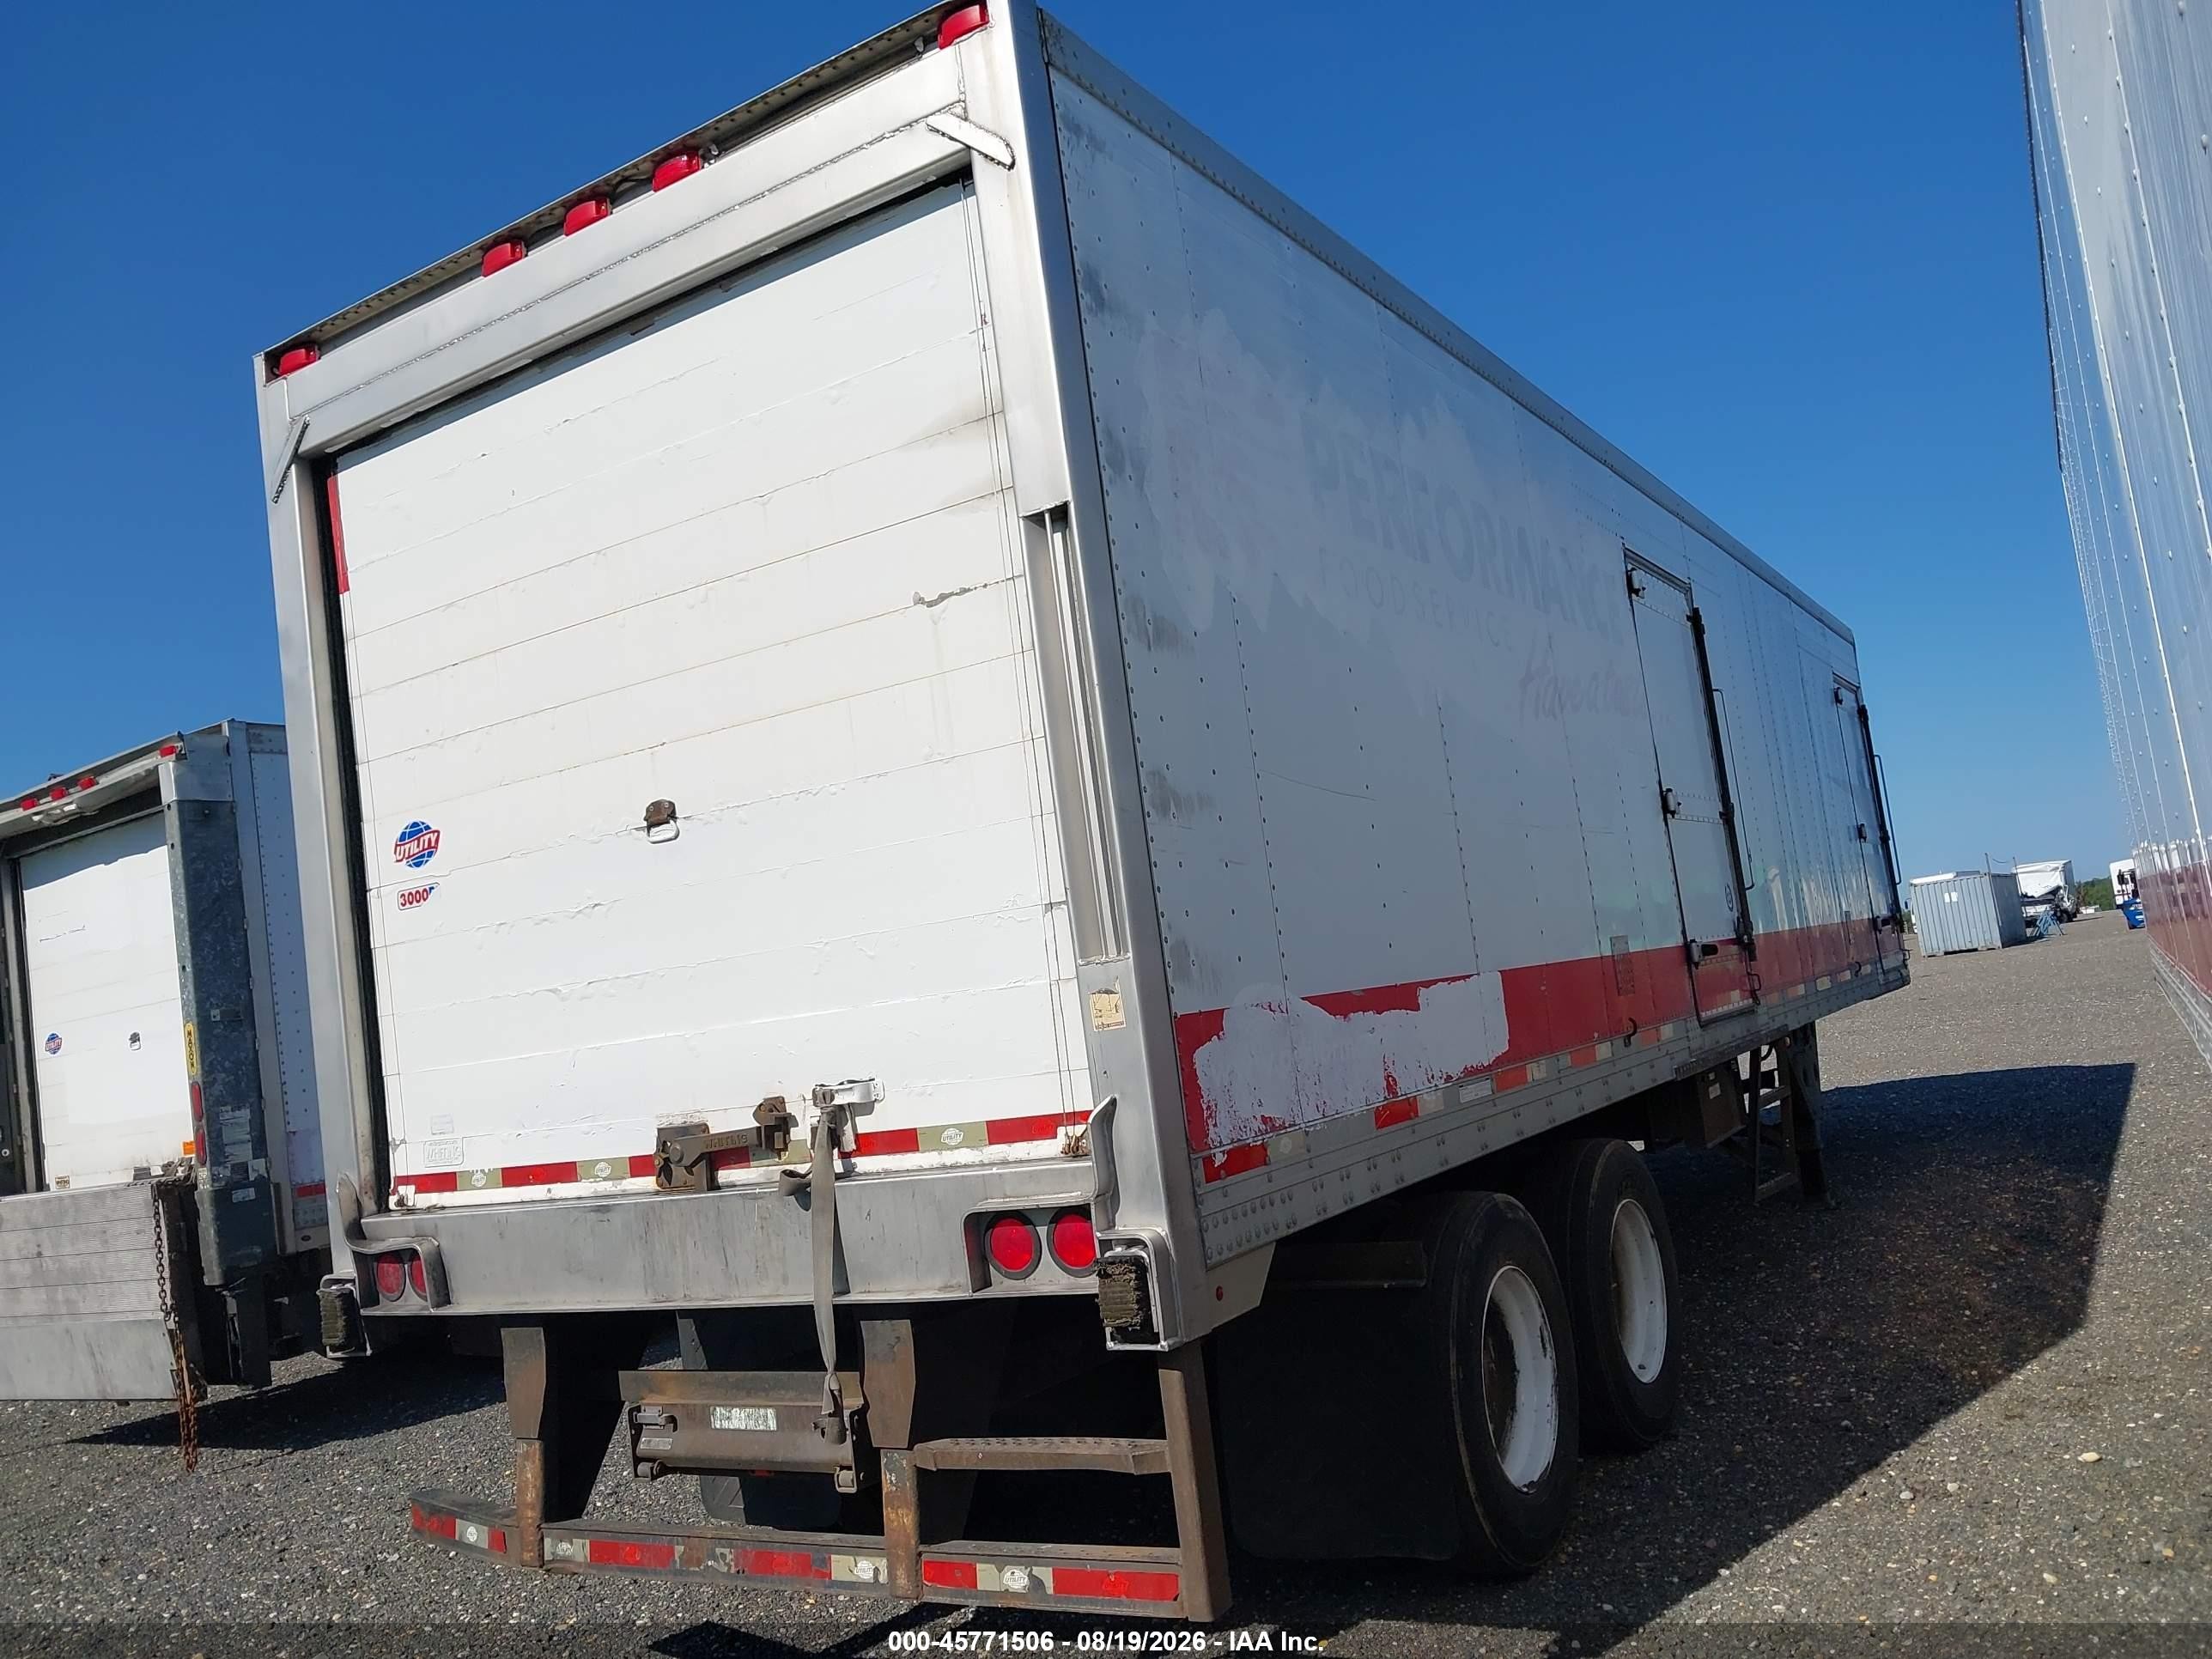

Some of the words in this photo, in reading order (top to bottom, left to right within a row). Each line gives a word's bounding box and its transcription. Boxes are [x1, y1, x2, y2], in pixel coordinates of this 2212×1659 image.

[396, 831, 439, 861] UTILITY
[186, 1030, 195, 1068] MAXON
[942, 1133, 963, 1142] UTILITY
